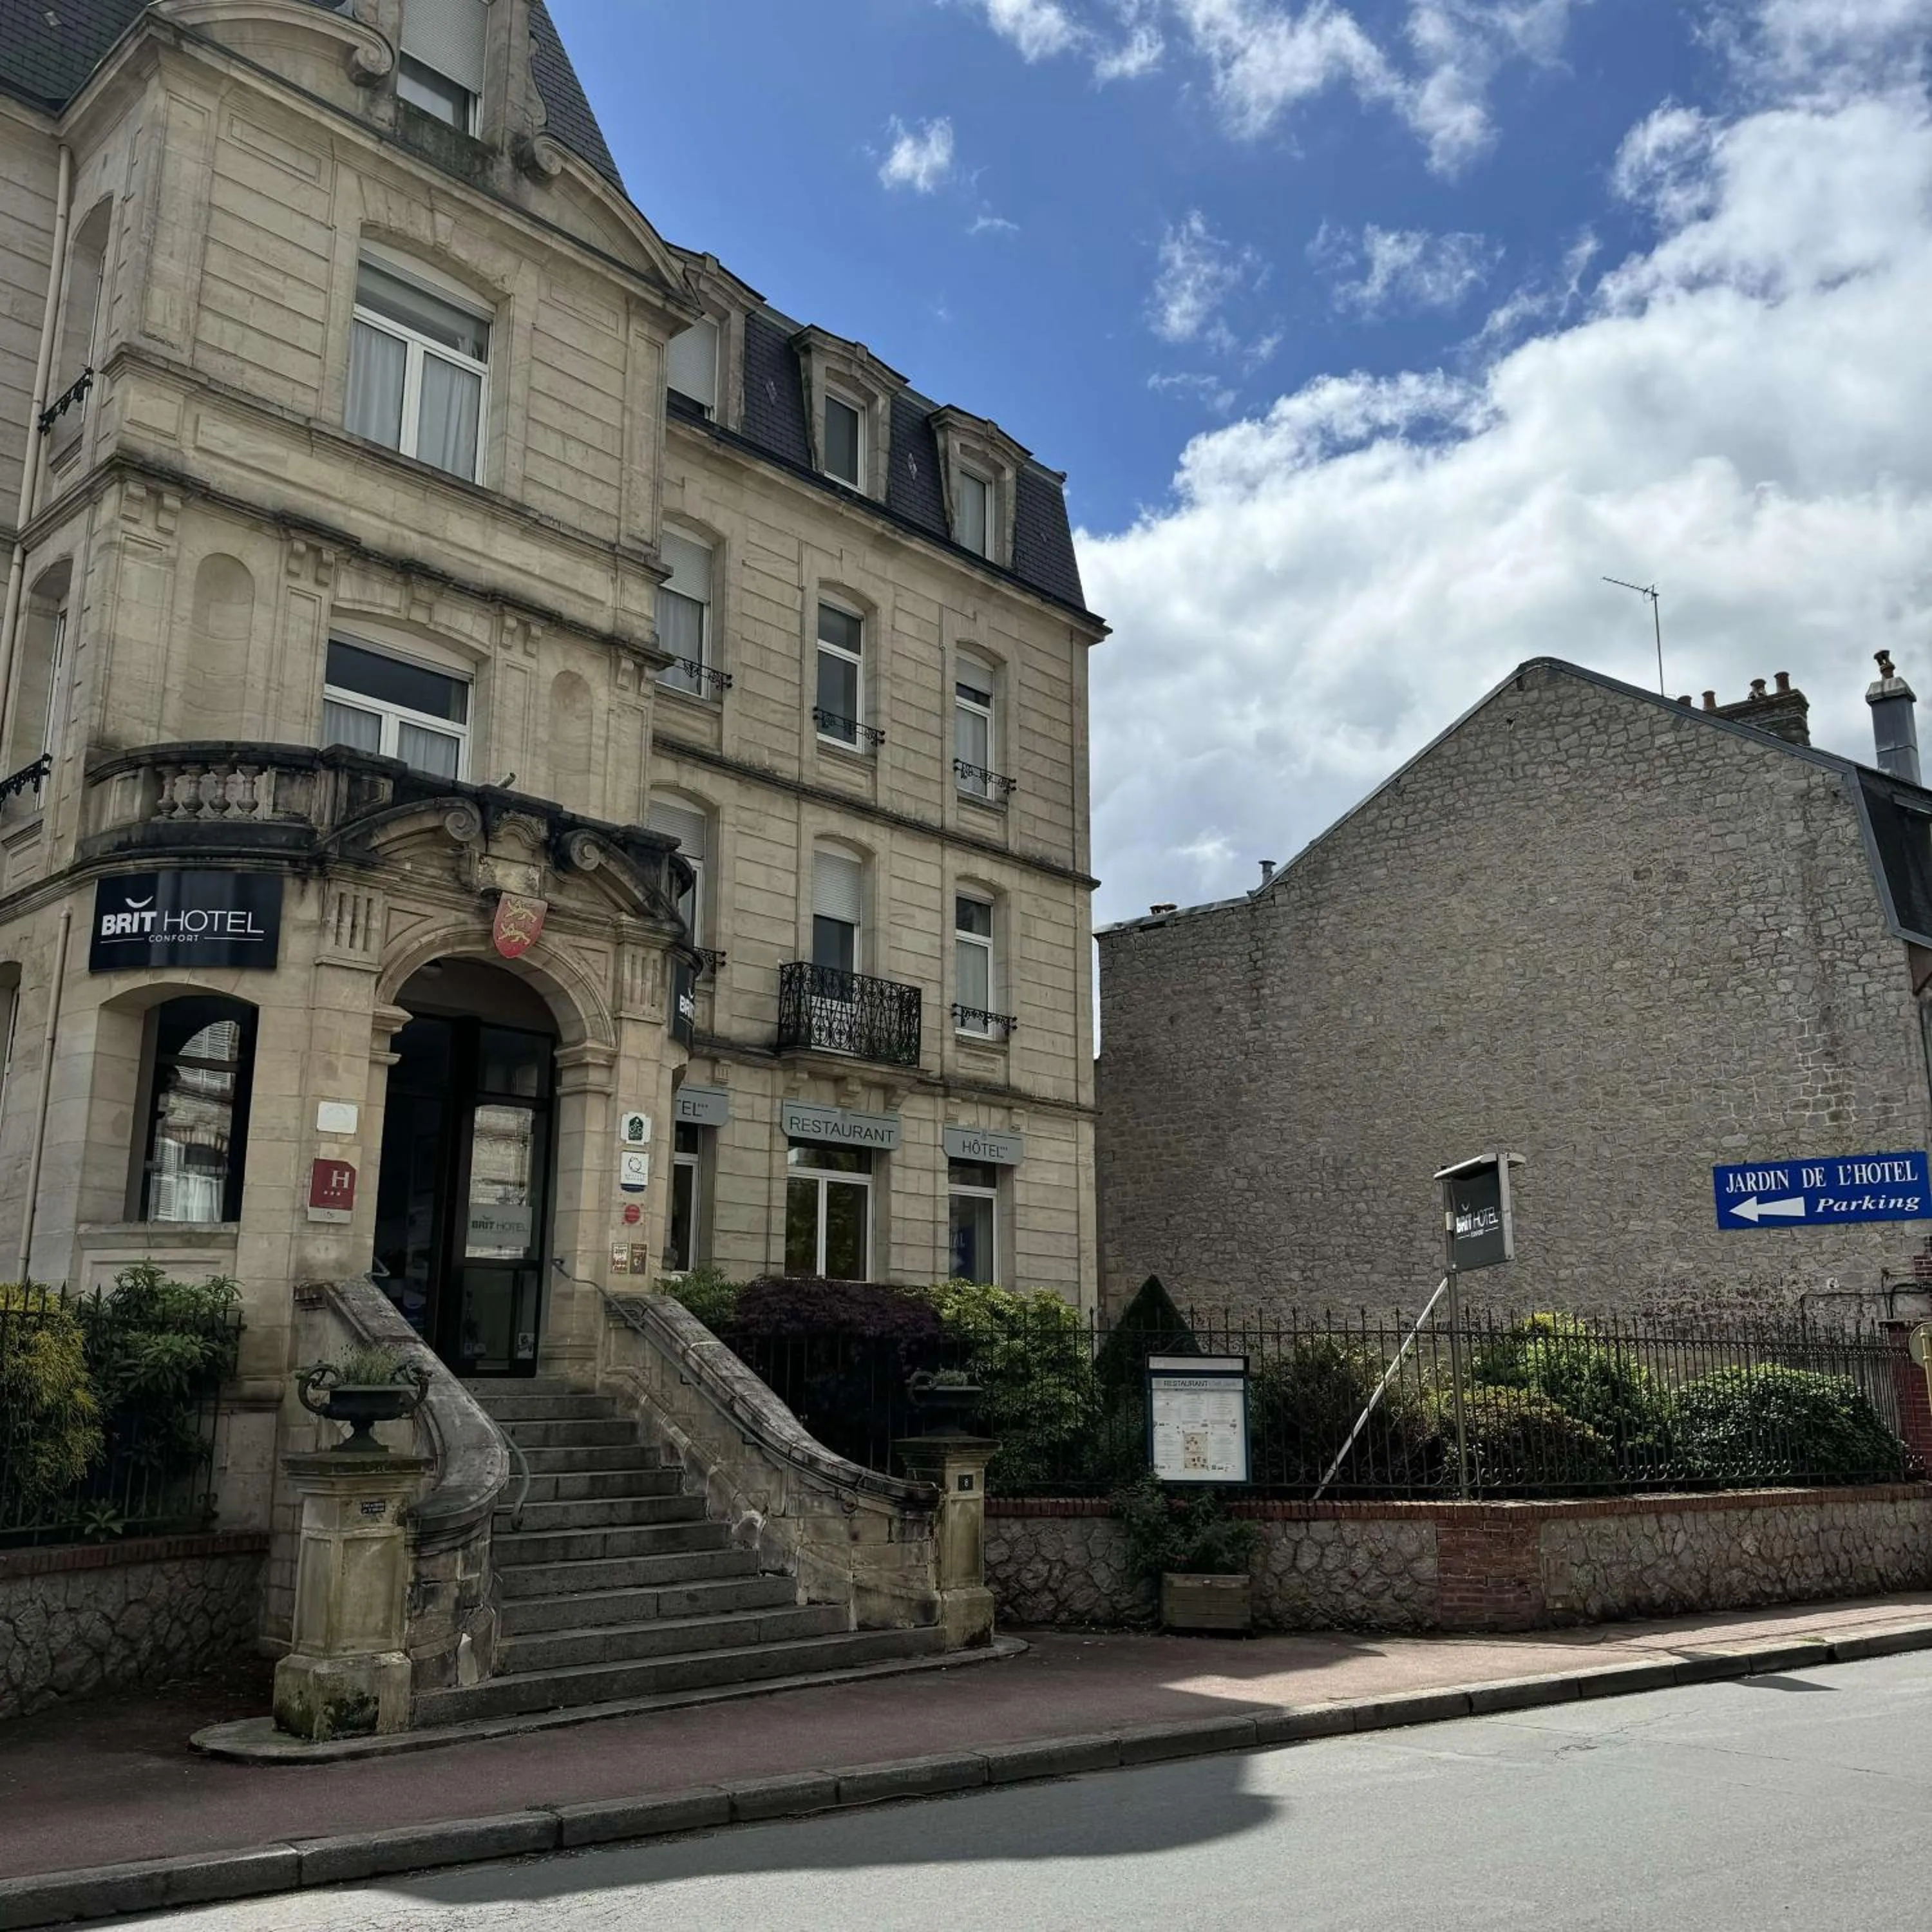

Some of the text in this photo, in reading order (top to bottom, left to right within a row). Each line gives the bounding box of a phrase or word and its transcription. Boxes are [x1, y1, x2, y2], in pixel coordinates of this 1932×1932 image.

[101, 910, 264, 936] BRIT HOTEL
[149, 934, 199, 943] CONFORT
[790, 1115, 895, 1143] RESTAURANT
[962, 1139, 1005, 1159] HÔTEL
[331, 1170, 350, 1188] H
[1726, 1160, 1918, 1193] JARDIN DE L'HOTEL
[1814, 1195, 1921, 1213] Parking
[471, 1220, 495, 1229] BRIT
[1473, 1206, 1499, 1229] HOTEL
